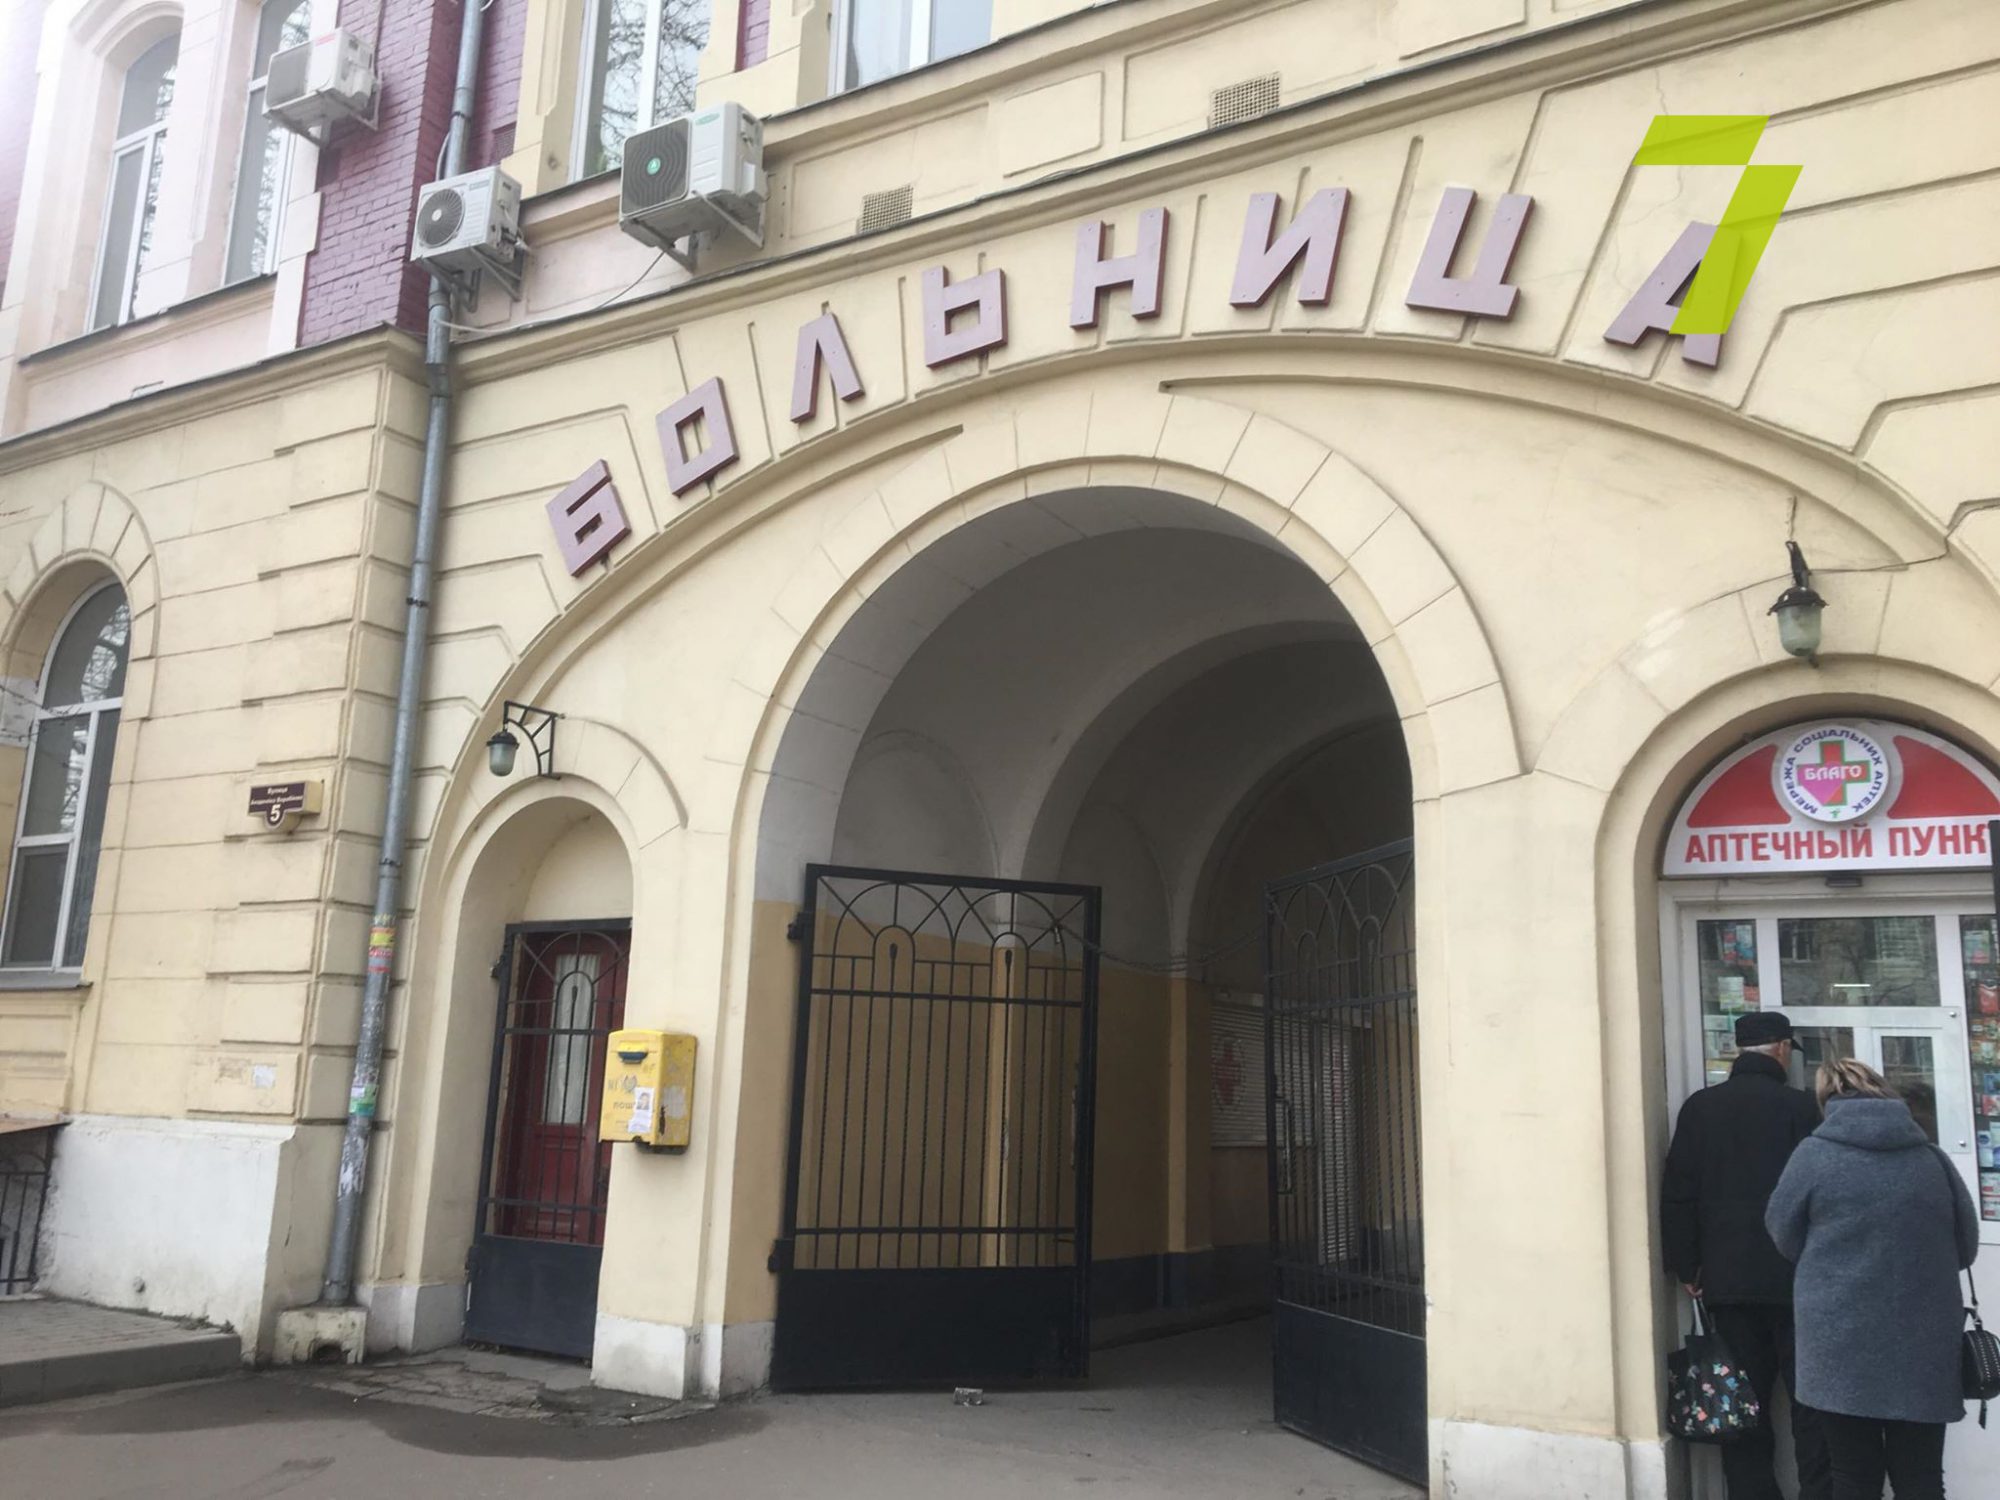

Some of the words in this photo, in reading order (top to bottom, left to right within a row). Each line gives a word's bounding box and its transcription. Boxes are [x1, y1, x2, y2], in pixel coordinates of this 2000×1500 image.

[545, 187, 1741, 577] БОЛЬНИЦА
[1794, 729, 1883, 766] СОЦІАЛЬНИХ
[1784, 757, 1818, 814] МЕРЕЖА
[1804, 765, 1862, 781] БЛАГО
[1852, 770, 1884, 812] АПТЕК
[270, 804, 281, 821] 5
[1685, 823, 1874, 863] АПТЕЧНЫЙ
[1889, 823, 1990, 857] ПУНК
